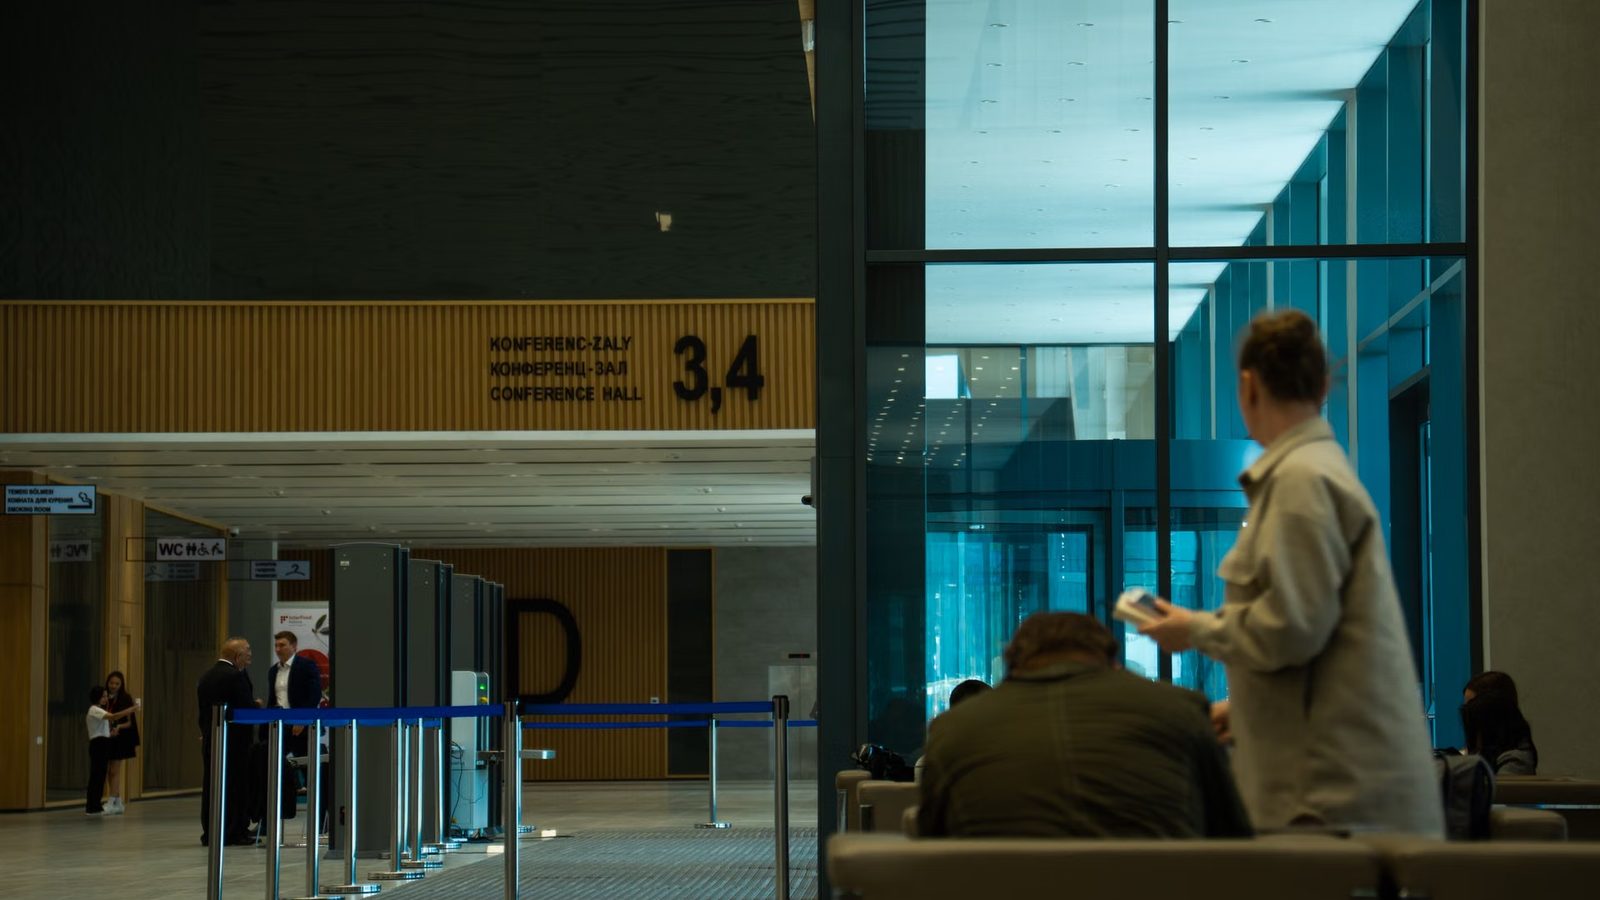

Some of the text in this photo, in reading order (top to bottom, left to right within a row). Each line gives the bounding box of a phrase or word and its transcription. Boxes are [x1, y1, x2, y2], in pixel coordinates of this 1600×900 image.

[490, 336, 632, 352] KONFERENC-ZALY
[673, 334, 764, 414] 3,4
[490, 386, 643, 402] CONFERENCE HALL
[159, 544, 183, 556] WC
[507, 598, 581, 705] D
